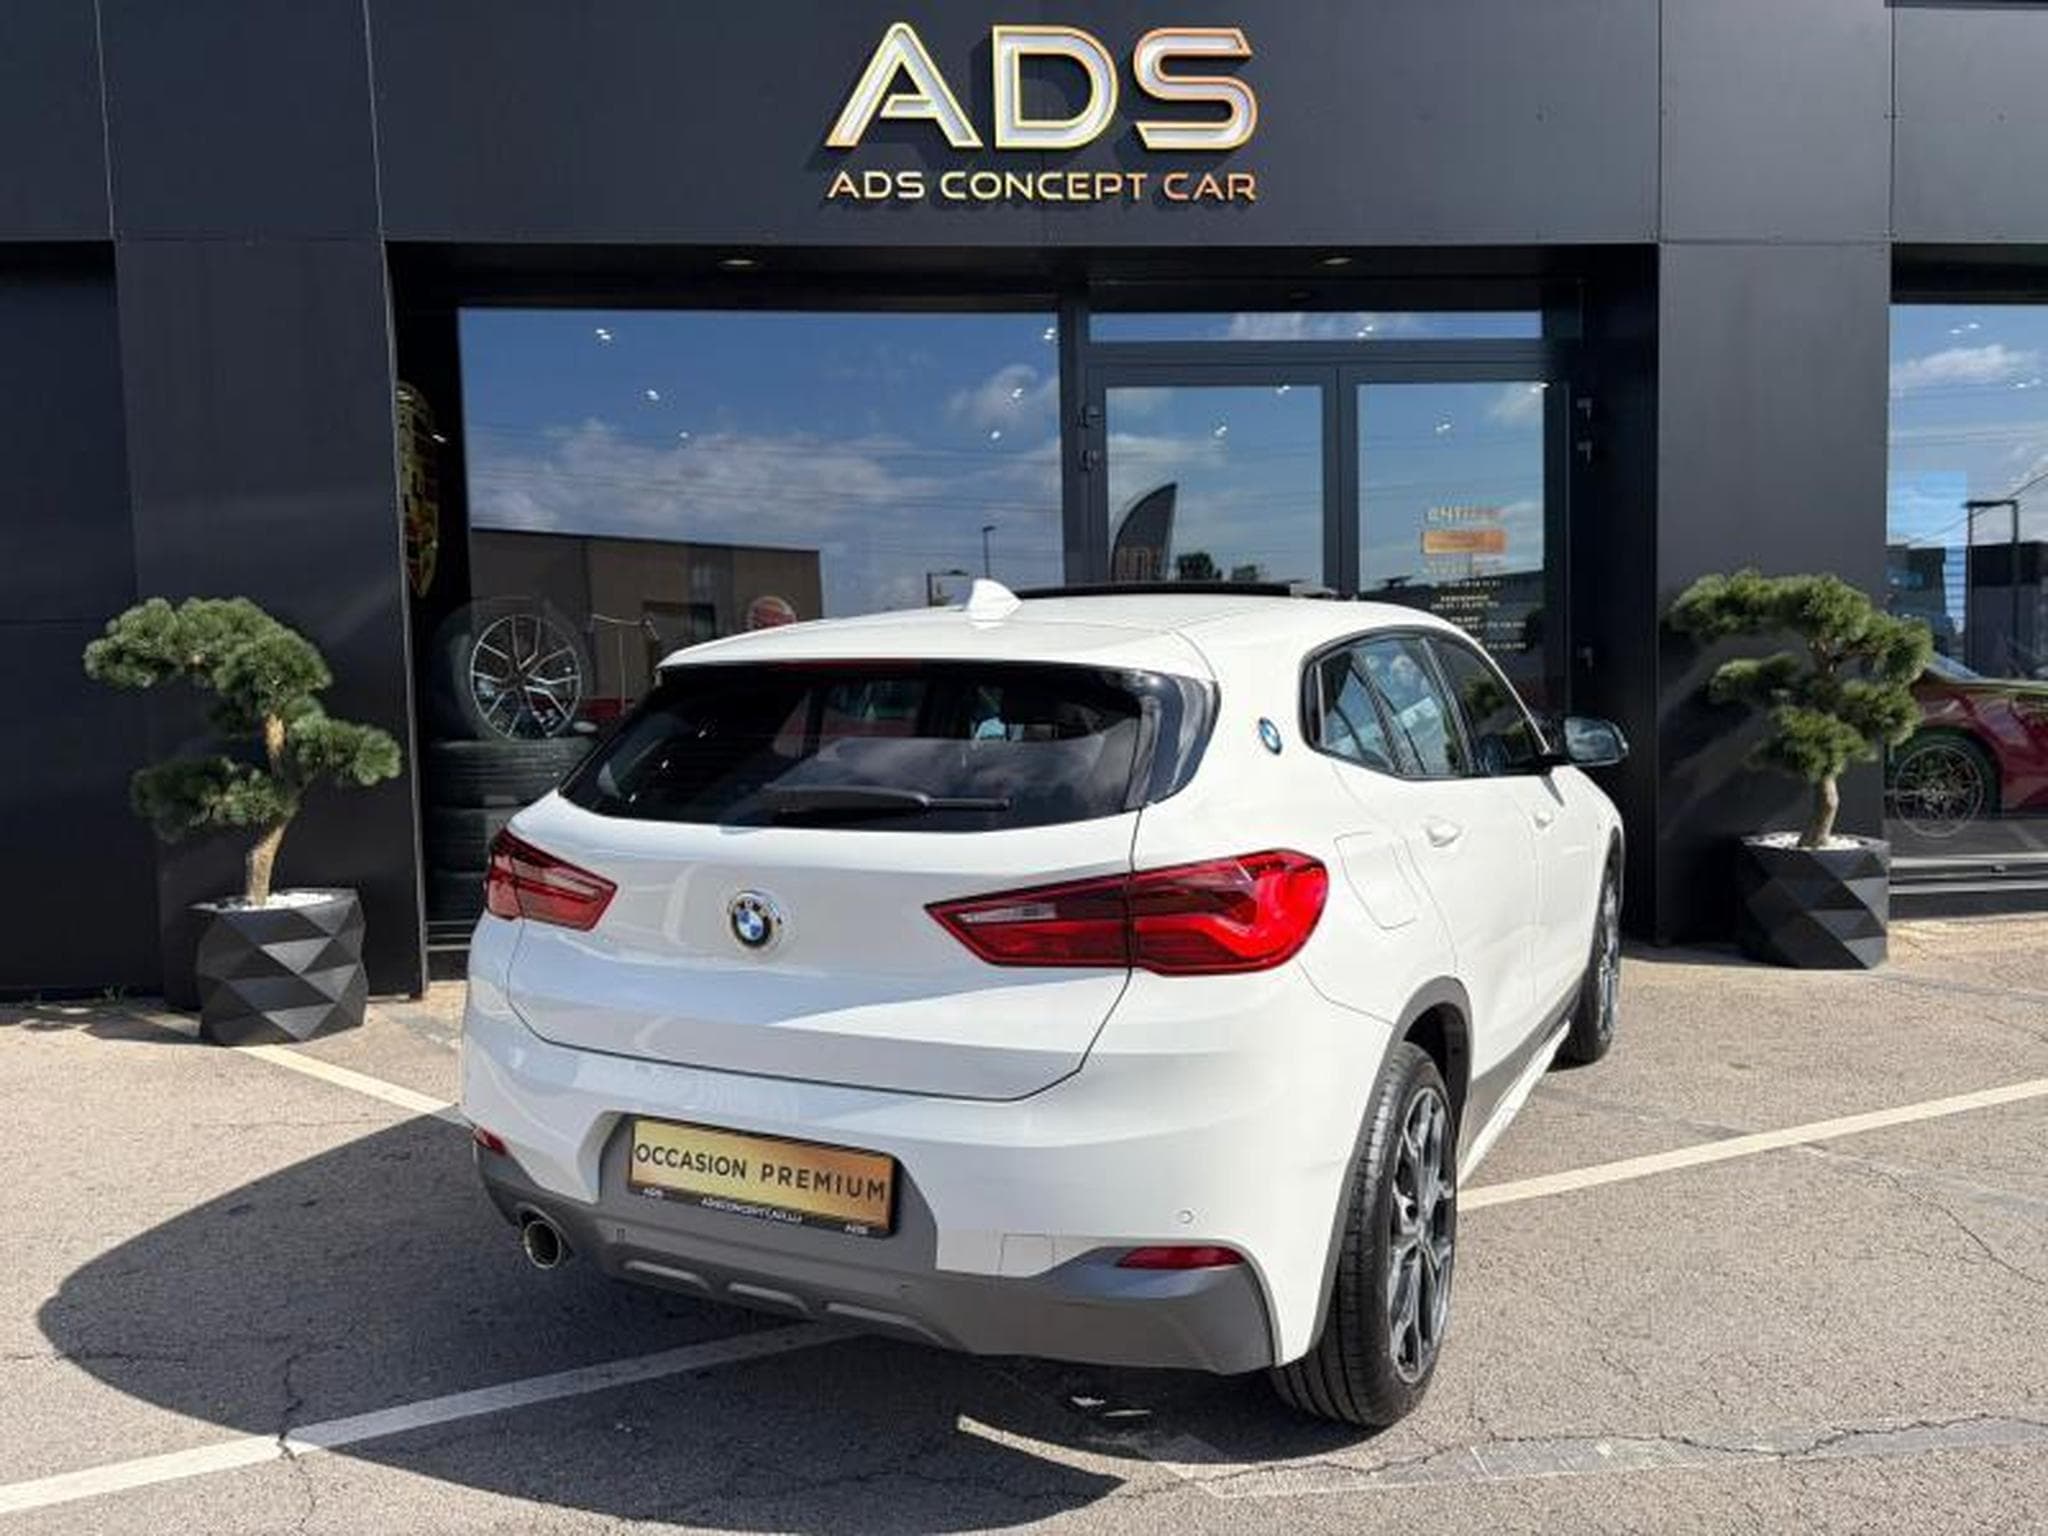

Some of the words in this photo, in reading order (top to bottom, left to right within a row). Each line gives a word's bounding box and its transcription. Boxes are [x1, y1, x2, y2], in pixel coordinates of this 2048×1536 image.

[824, 21, 1259, 150] ADS
[826, 170, 926, 200] ADS
[939, 171, 1148, 201] CONCEPT
[1162, 172, 1258, 201] CAR
[635, 1142, 747, 1179] OCCASION
[760, 1162, 886, 1202] PREMIUM
